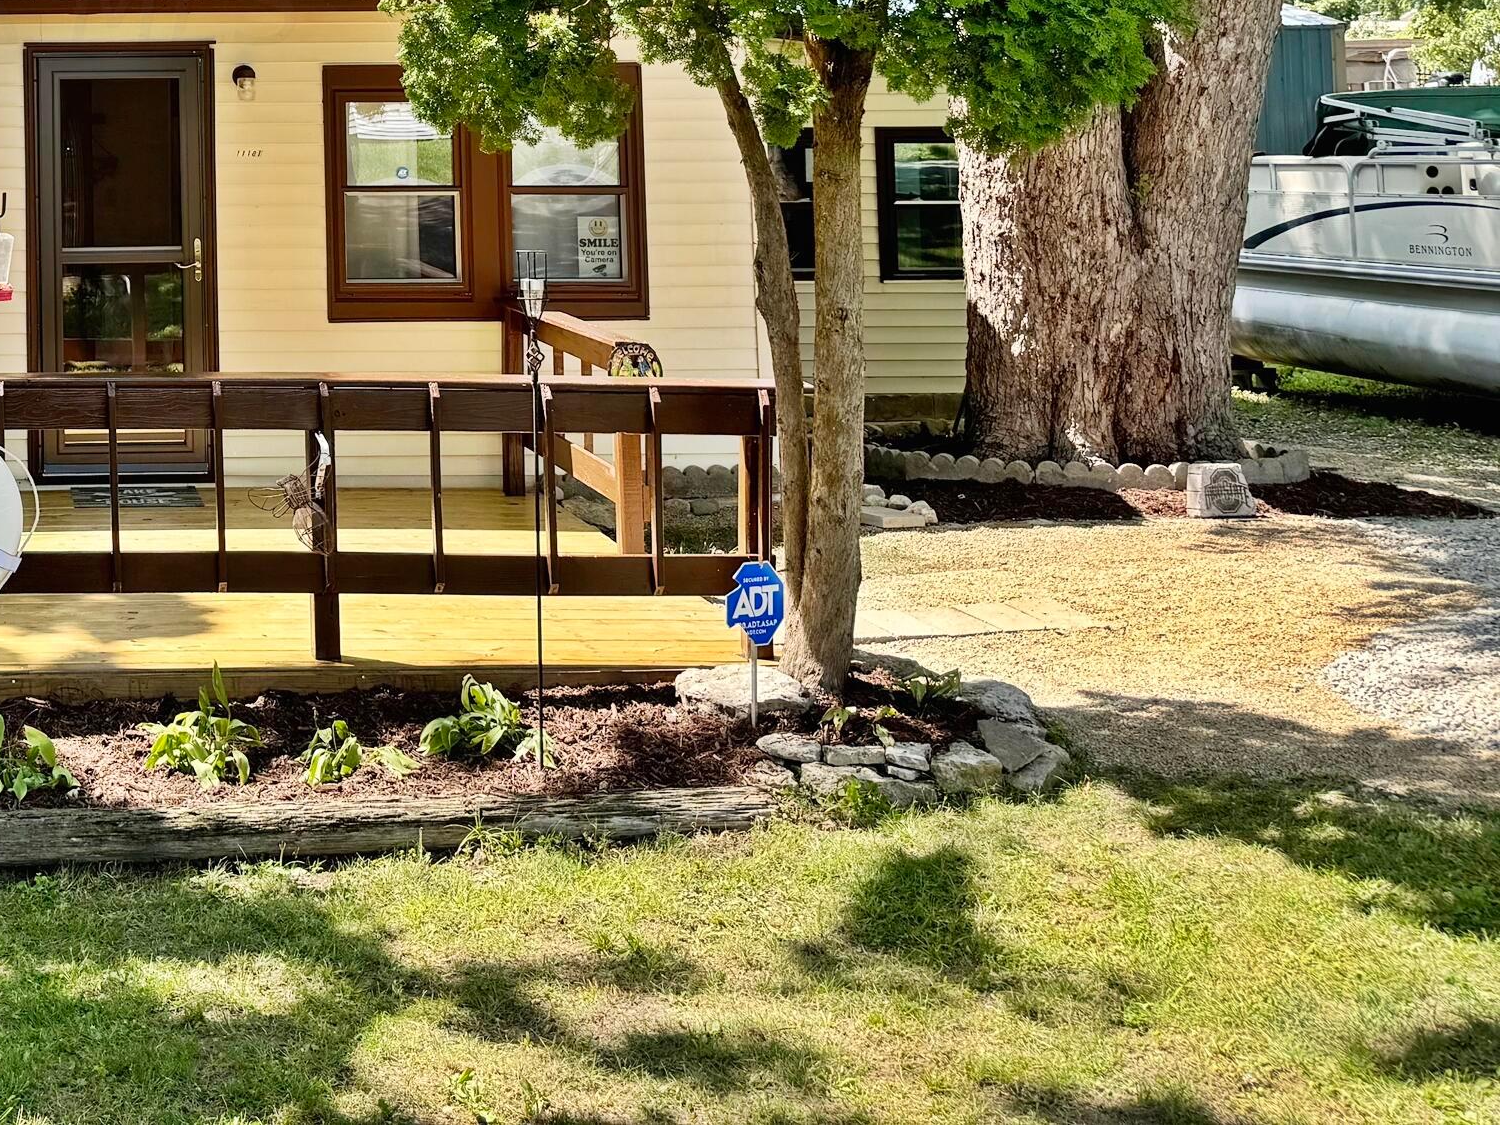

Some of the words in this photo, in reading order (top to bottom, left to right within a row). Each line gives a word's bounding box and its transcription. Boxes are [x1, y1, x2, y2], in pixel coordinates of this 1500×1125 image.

[579, 238, 619, 248] SMILE
[581, 248, 605, 257] You're
[1408, 243, 1473, 257] BENNINGTON
[732, 584, 779, 619] ADT
